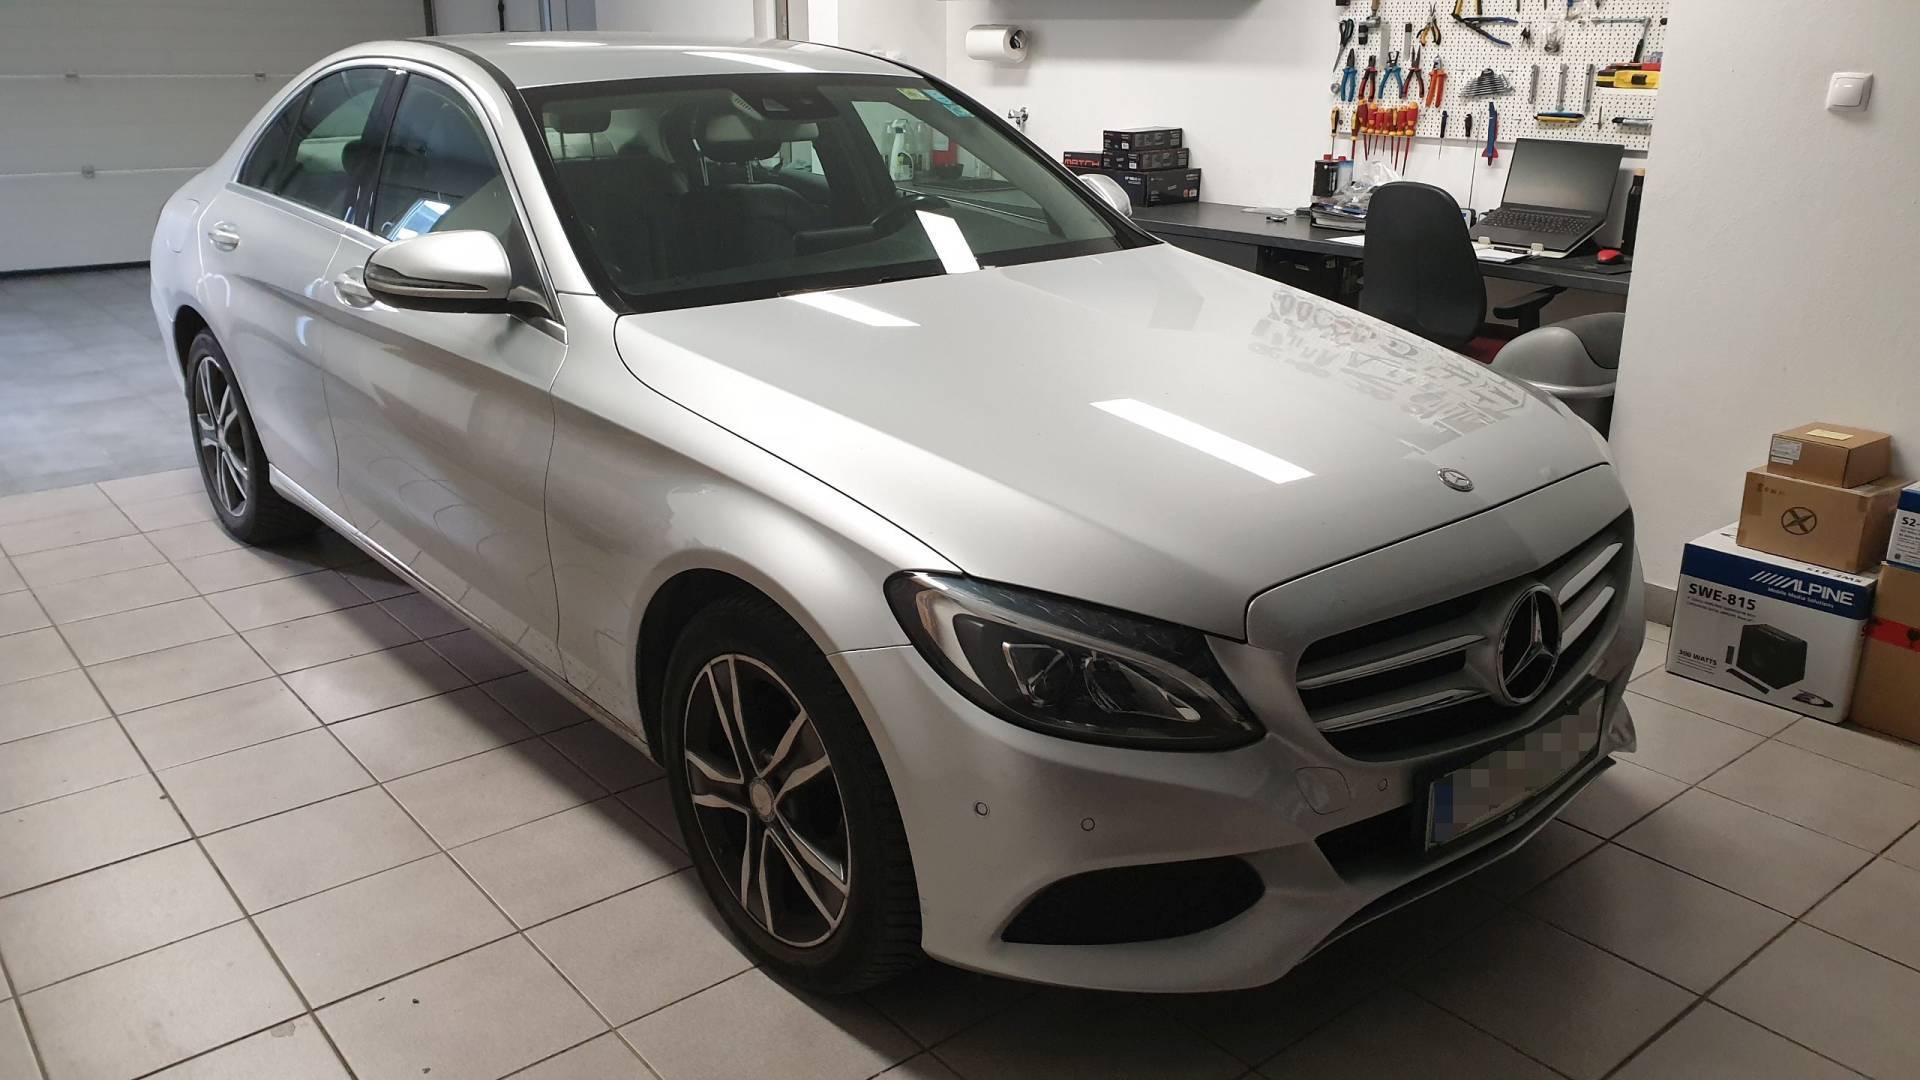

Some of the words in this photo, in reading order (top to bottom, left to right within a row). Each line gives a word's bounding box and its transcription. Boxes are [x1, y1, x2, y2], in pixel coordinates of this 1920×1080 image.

[1688, 583, 1757, 610] SWE-815
[1750, 571, 1855, 606] ALPINE
[1692, 653, 1717, 666] WATTS
